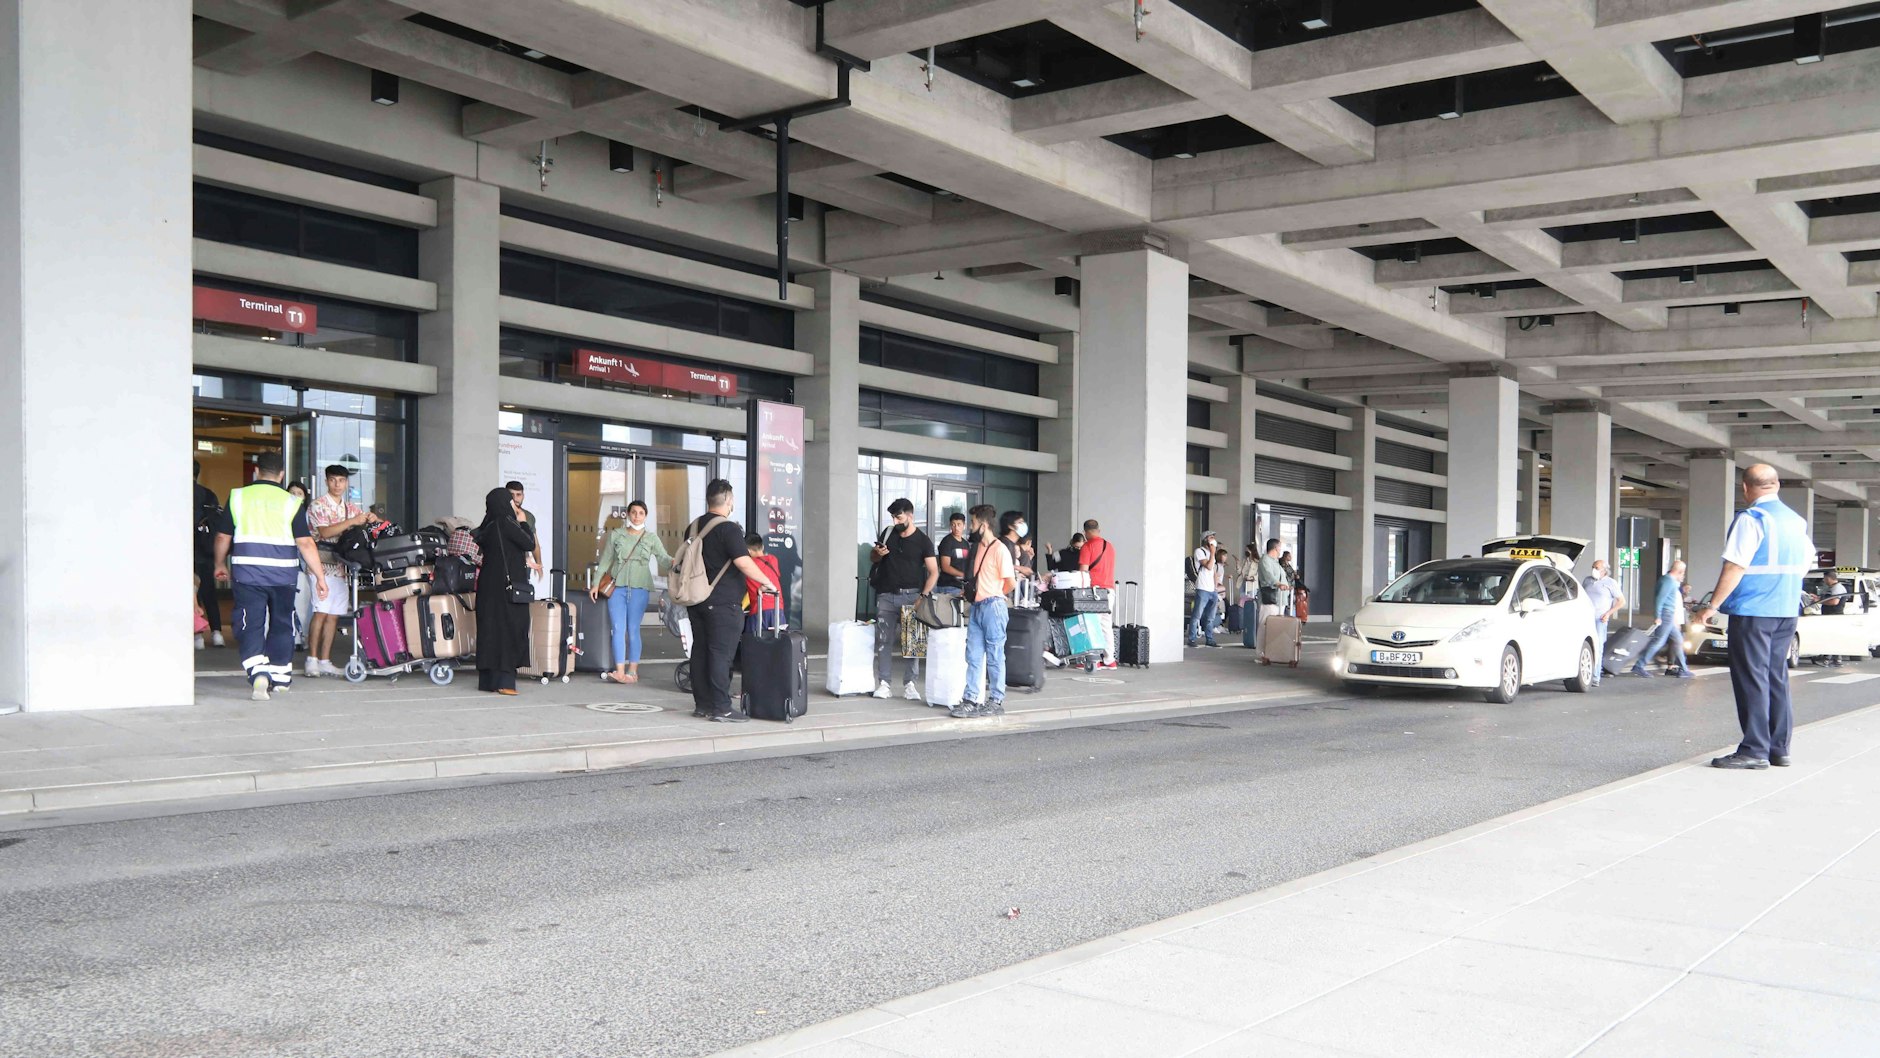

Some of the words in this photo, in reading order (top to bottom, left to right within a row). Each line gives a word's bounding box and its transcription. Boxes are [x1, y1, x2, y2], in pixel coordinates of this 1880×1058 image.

[240, 298, 283, 314] Terminal
[288, 311, 303, 324] T1
[589, 355, 618, 368] Ankunft
[619, 360, 623, 368] 1
[589, 364, 607, 372] Arrival
[690, 371, 717, 382] Terminal
[719, 379, 730, 389] T1
[764, 411, 773, 421] T1
[762, 432, 784, 442] Ankunft
[1379, 652, 1385, 661] B
[1390, 653, 1400, 661] BF
[1402, 653, 1417, 662] 291
